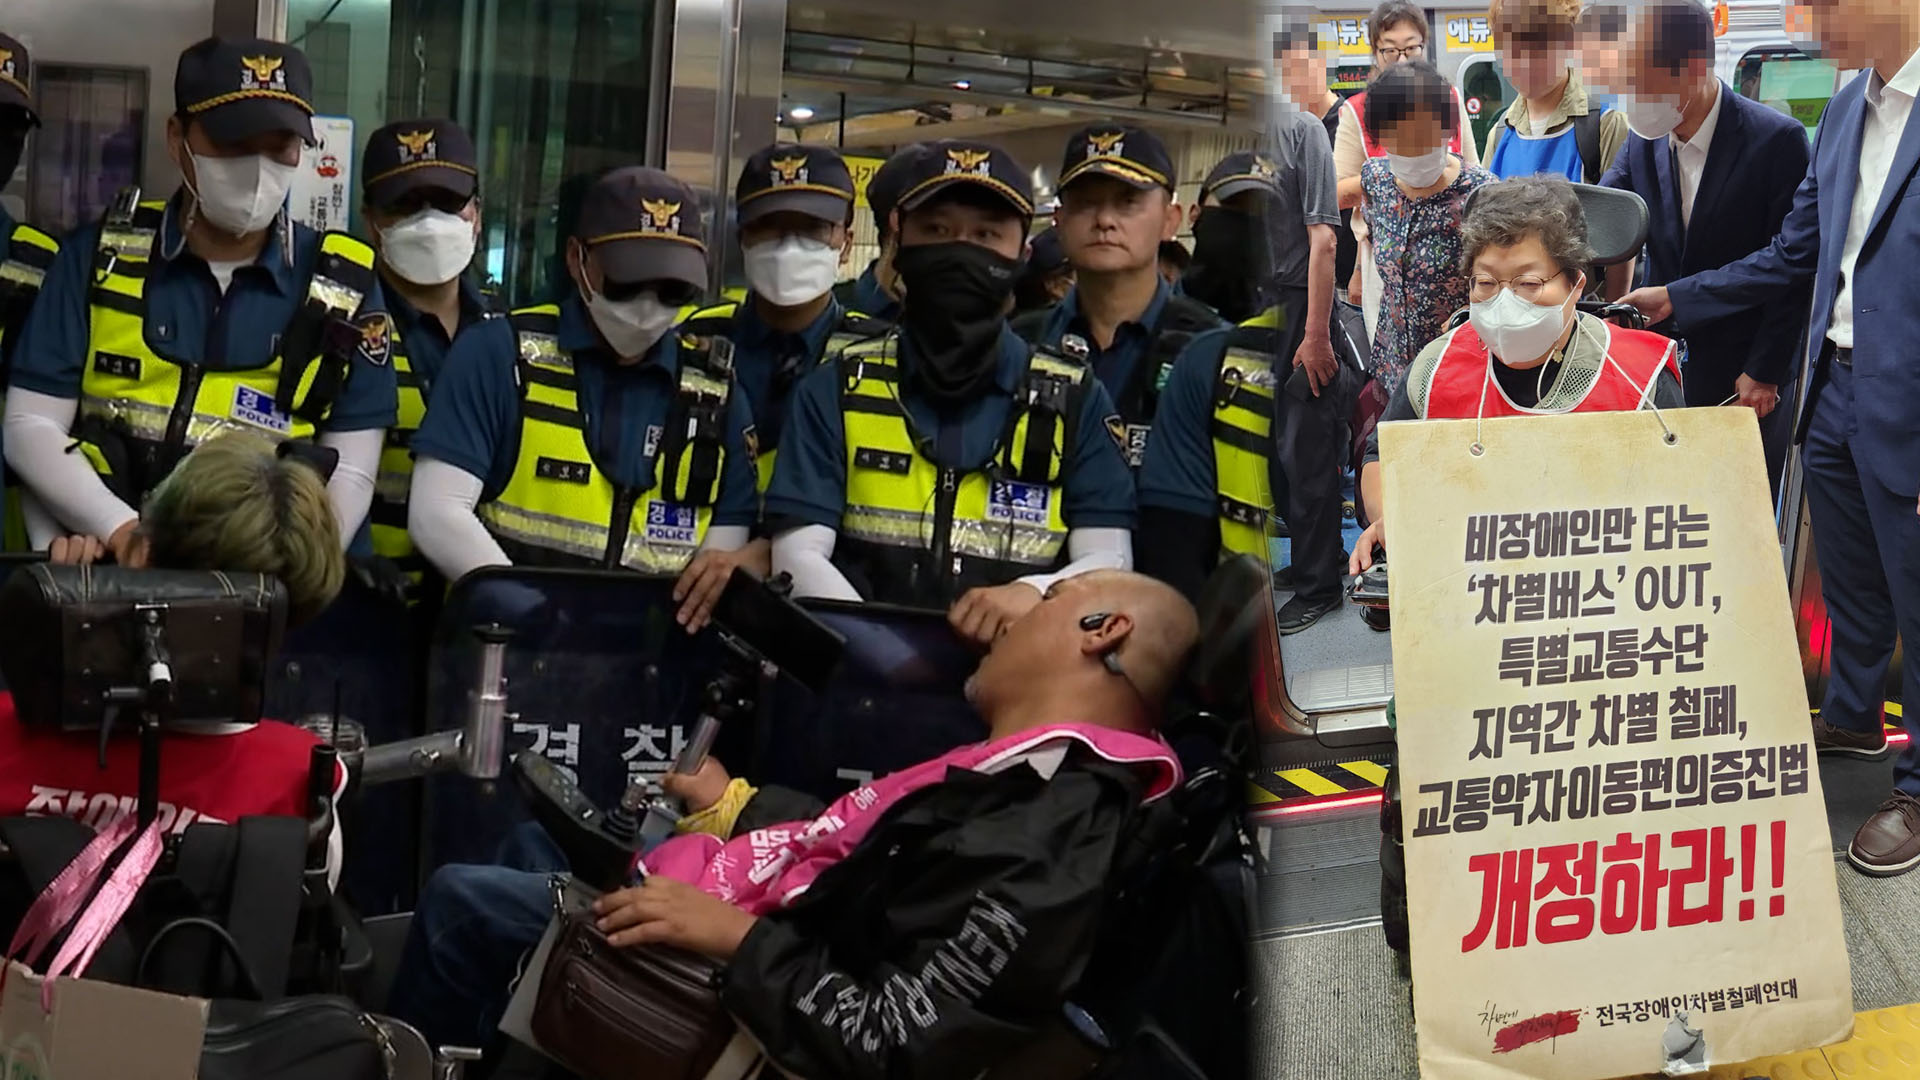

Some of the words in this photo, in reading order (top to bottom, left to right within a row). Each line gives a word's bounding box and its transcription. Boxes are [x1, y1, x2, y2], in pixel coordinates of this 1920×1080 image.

[648, 528, 694, 541] POLICE
[1465, 507, 1636, 562] 비장애인만
[1644, 504, 1710, 551] 타는
[1635, 562, 1721, 614] OUT,
[1498, 623, 1708, 687] 특별교통수단
[1468, 697, 1581, 761] 지역간
[1588, 691, 1659, 747] 차별
[1668, 684, 1748, 741] 철폐,
[1412, 743, 1809, 838] 교통약자이동편의증진법
[1461, 820, 1787, 953] 개정하라!!
[1596, 978, 1798, 1027] 전국장애인차별철폐연대
